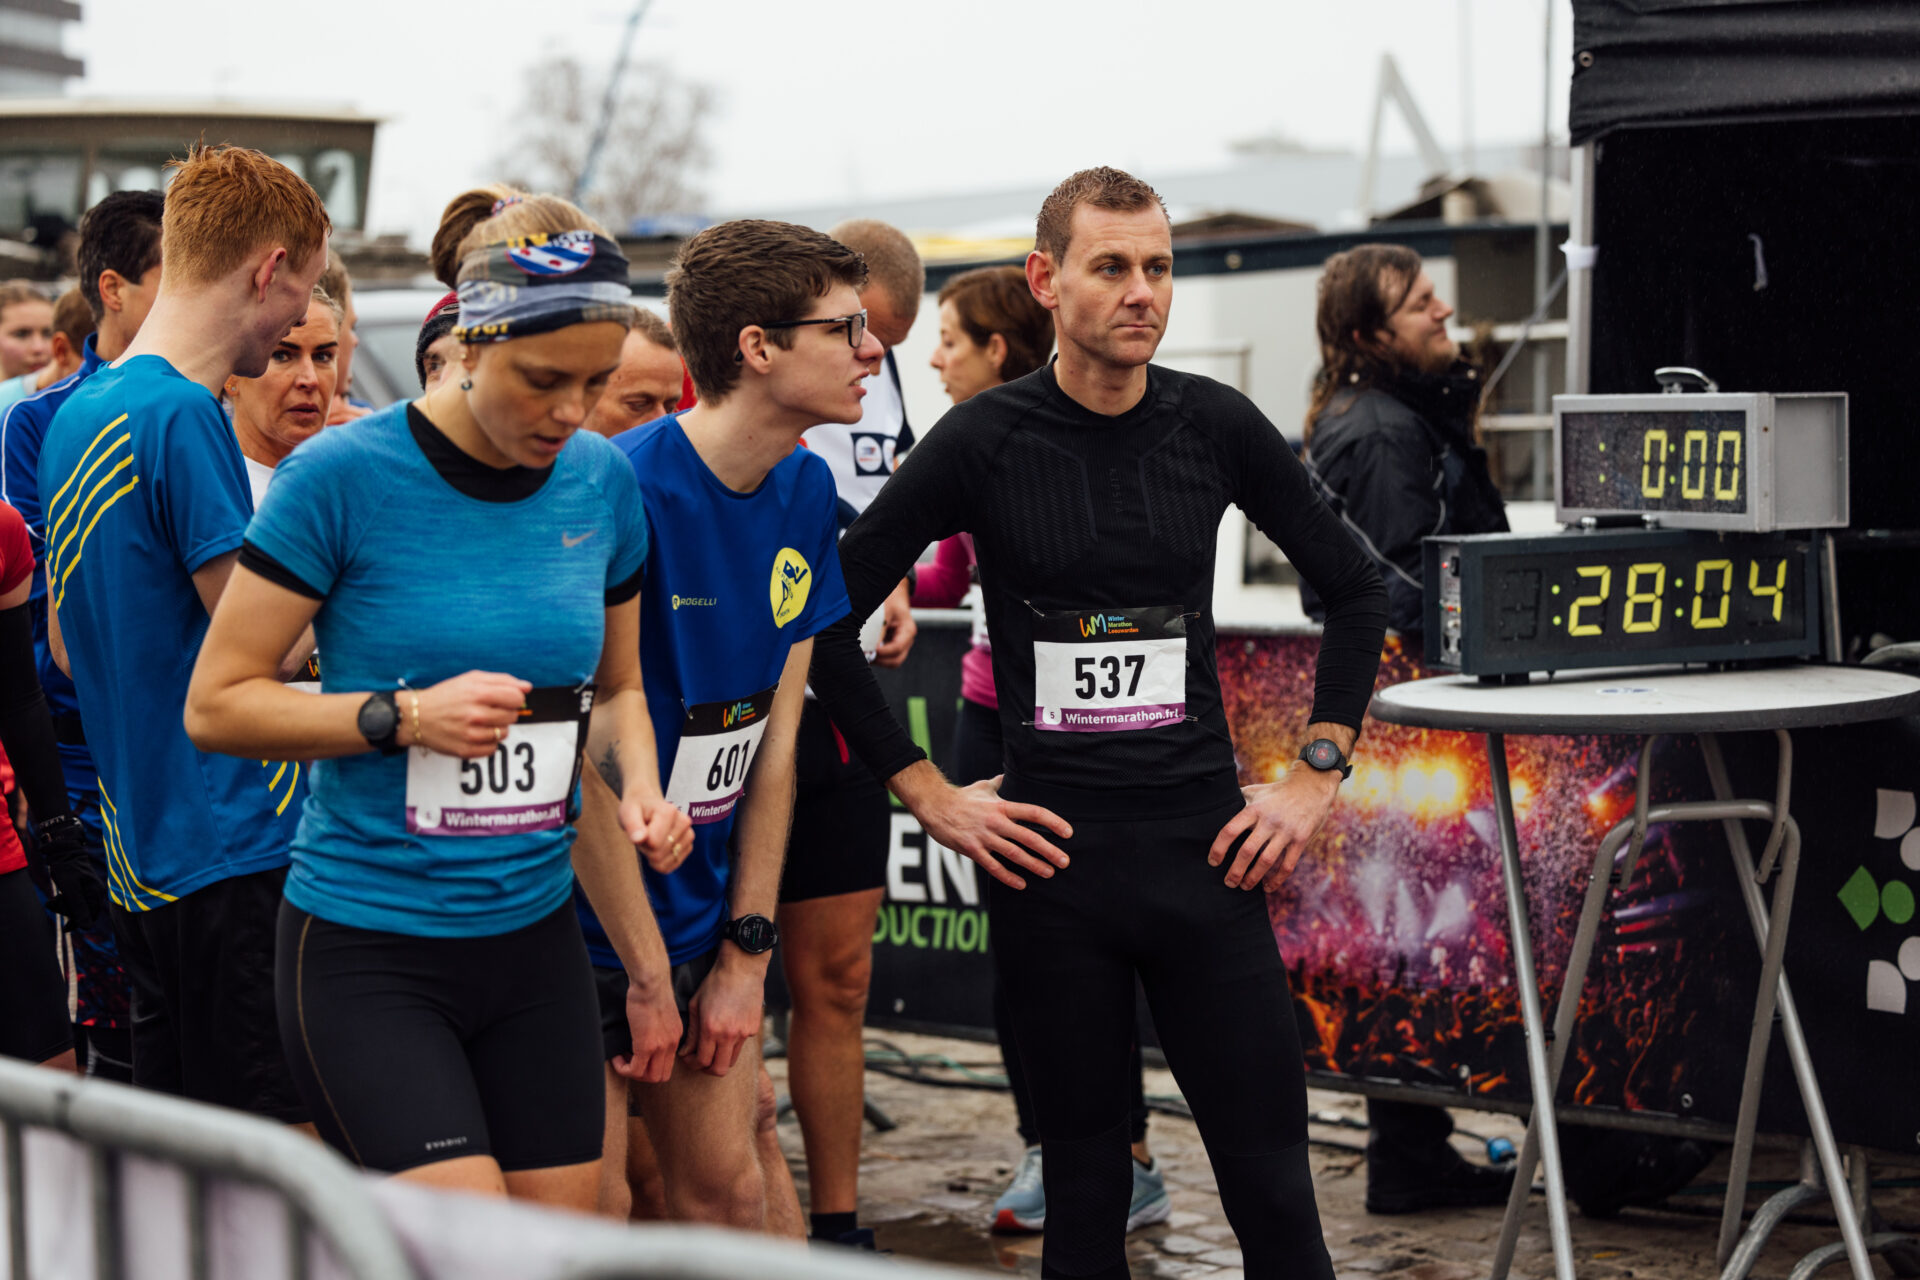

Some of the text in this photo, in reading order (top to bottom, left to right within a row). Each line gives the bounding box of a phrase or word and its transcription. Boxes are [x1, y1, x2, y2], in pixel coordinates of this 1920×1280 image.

[680, 598, 717, 606] ROGELLI
[1075, 654, 1146, 700] 537
[1050, 711, 1055, 719] 5
[1065, 708, 1179, 725] Wintermarathon.frl
[460, 742, 536, 796] 503
[706, 739, 751, 791] 601
